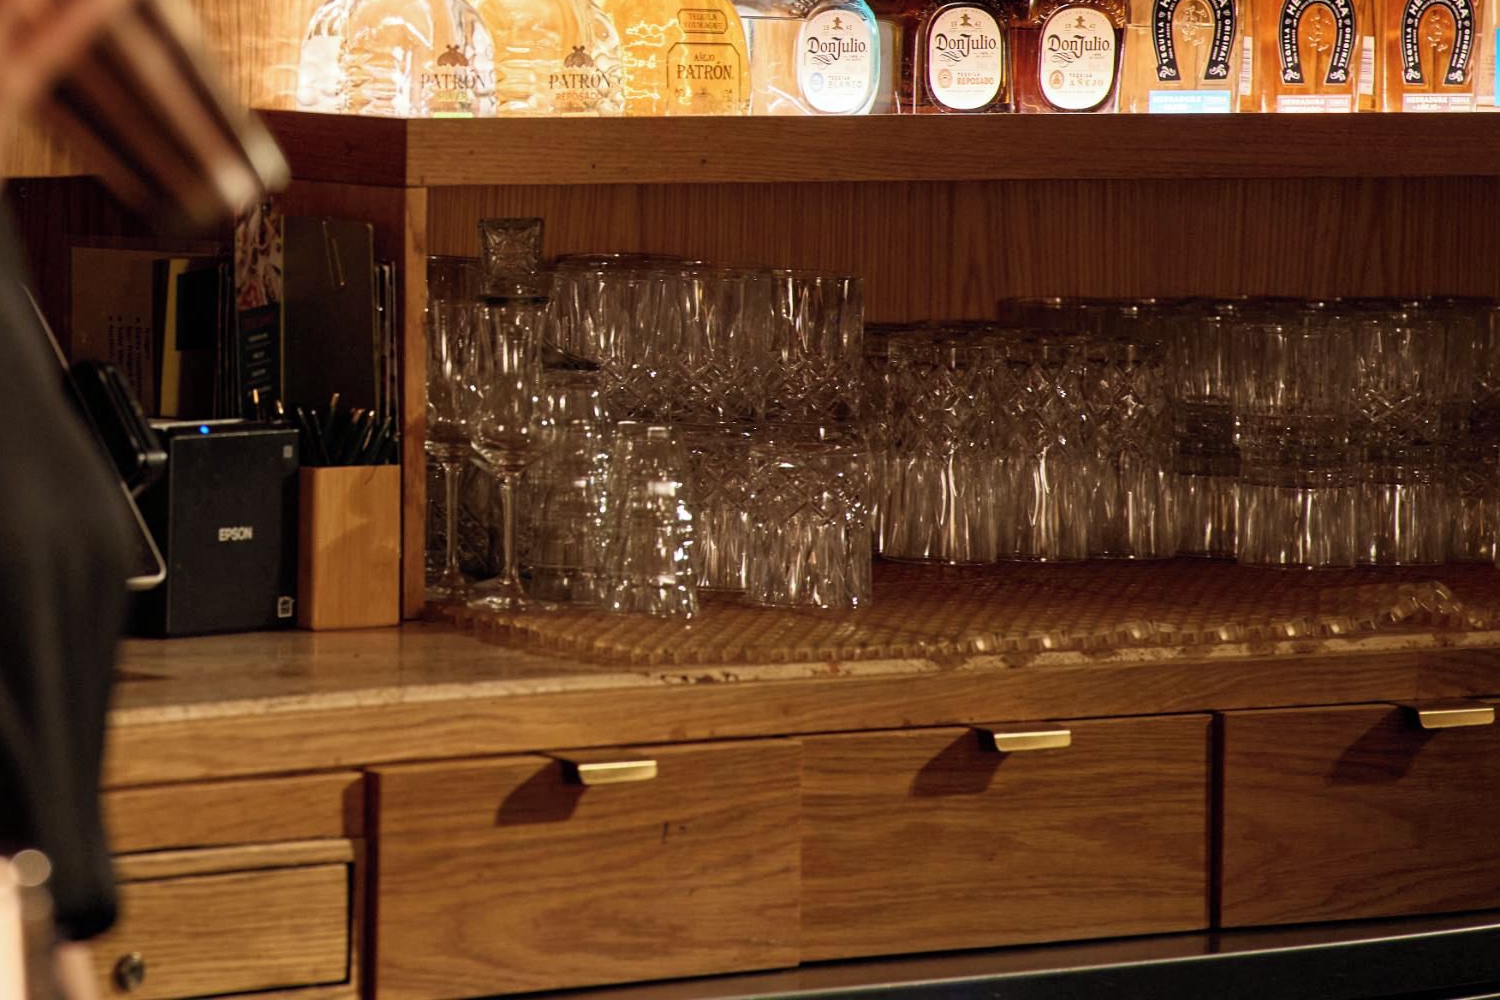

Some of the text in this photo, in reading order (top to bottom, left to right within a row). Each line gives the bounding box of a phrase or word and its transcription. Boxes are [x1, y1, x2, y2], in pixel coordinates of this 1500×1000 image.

[807, 36, 866, 61] Don Julio
[935, 32, 997, 58] Don Julio
[1047, 34, 1110, 59] Don Julio
[1157, 20, 1169, 64] TEQUILA
[1217, 18, 1232, 62] ORIGINAL
[1284, 27, 1294, 67] TEQUILA
[1337, 27, 1351, 68] ORIGINAL
[1405, 26, 1415, 67] TEQUILA
[1456, 28, 1471, 69] ORIGINAL
[420, 68, 486, 89] PATRÓN
[549, 68, 611, 89] PATRÓN
[676, 61, 733, 80] PATRÓN
[957, 77, 994, 85] REPOSADO
[1069, 78, 1105, 87] AÑEJO
[555, 92, 609, 101] REPOSADO
[218, 526, 253, 542] EPSON
